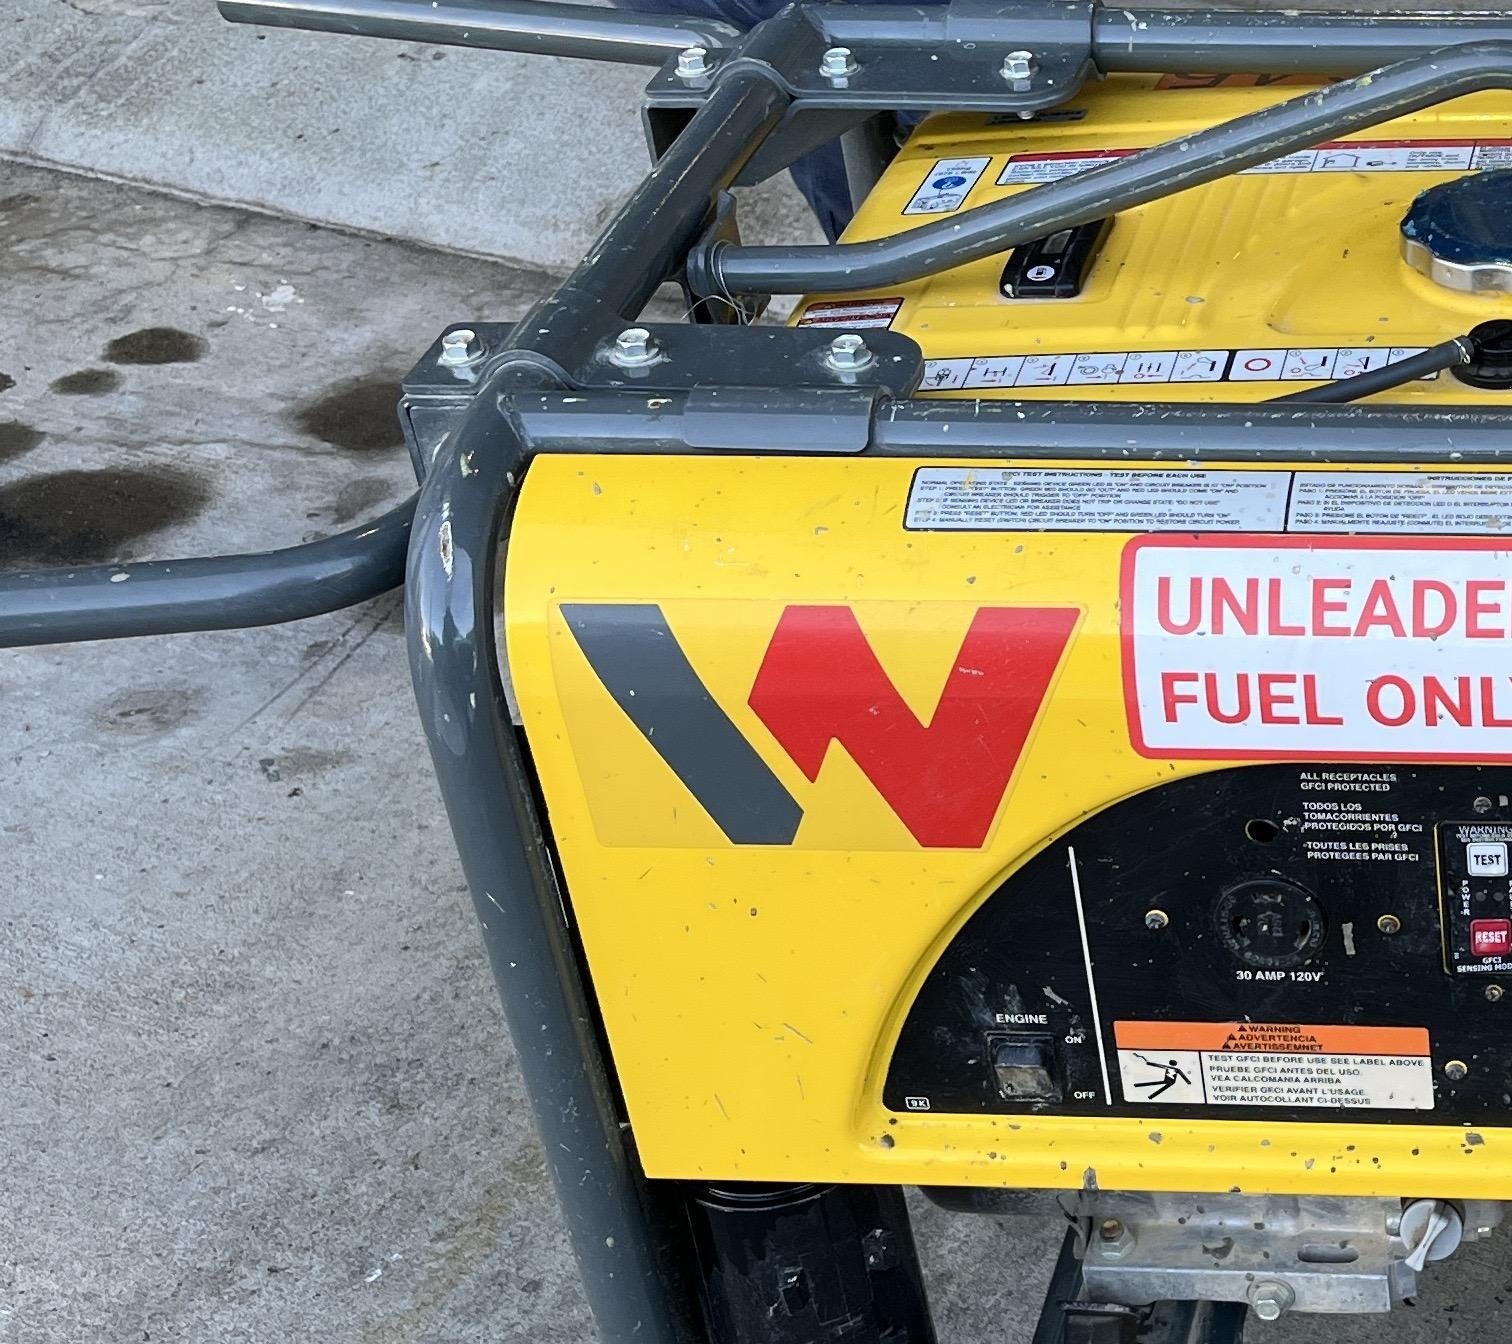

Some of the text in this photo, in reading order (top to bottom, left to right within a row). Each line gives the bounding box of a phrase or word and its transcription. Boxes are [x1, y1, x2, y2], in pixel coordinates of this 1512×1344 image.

[1161, 672, 1344, 725] FUEL
[1300, 772, 1397, 782] ALL RECEPTACLES
[1301, 782, 1390, 791] GFCI PROTECTED
[1303, 802, 1338, 810] TODOS
[1303, 812, 1399, 821] TOMACORRIENTES
[1304, 822, 1422, 832] PROTEGIDOS POR GFCI
[1307, 842, 1408, 851] TOUTES LES PRISES
[1307, 851, 1370, 860] PROTEGEES
[1395, 853, 1419, 861] GFCI
[1474, 854, 1500, 865] TEST
[1461, 880, 1470, 916] POWER
[1475, 930, 1508, 944] RESET
[1456, 964, 1492, 973] SENSING
[1236, 971, 1321, 981] 30 AMP 120V
[996, 1014, 1048, 1024] ENGINE
[1249, 1025, 1301, 1034] WARNING
[1065, 1036, 1082, 1044] ON
[1238, 1034, 1316, 1043] ADVERTENCIA
[1208, 1055, 1233, 1063] TEST
[1263, 1056, 1304, 1064] BEFORE
[1389, 1059, 1424, 1067] ABOVE
[1279, 1067, 1313, 1075] ANTES
